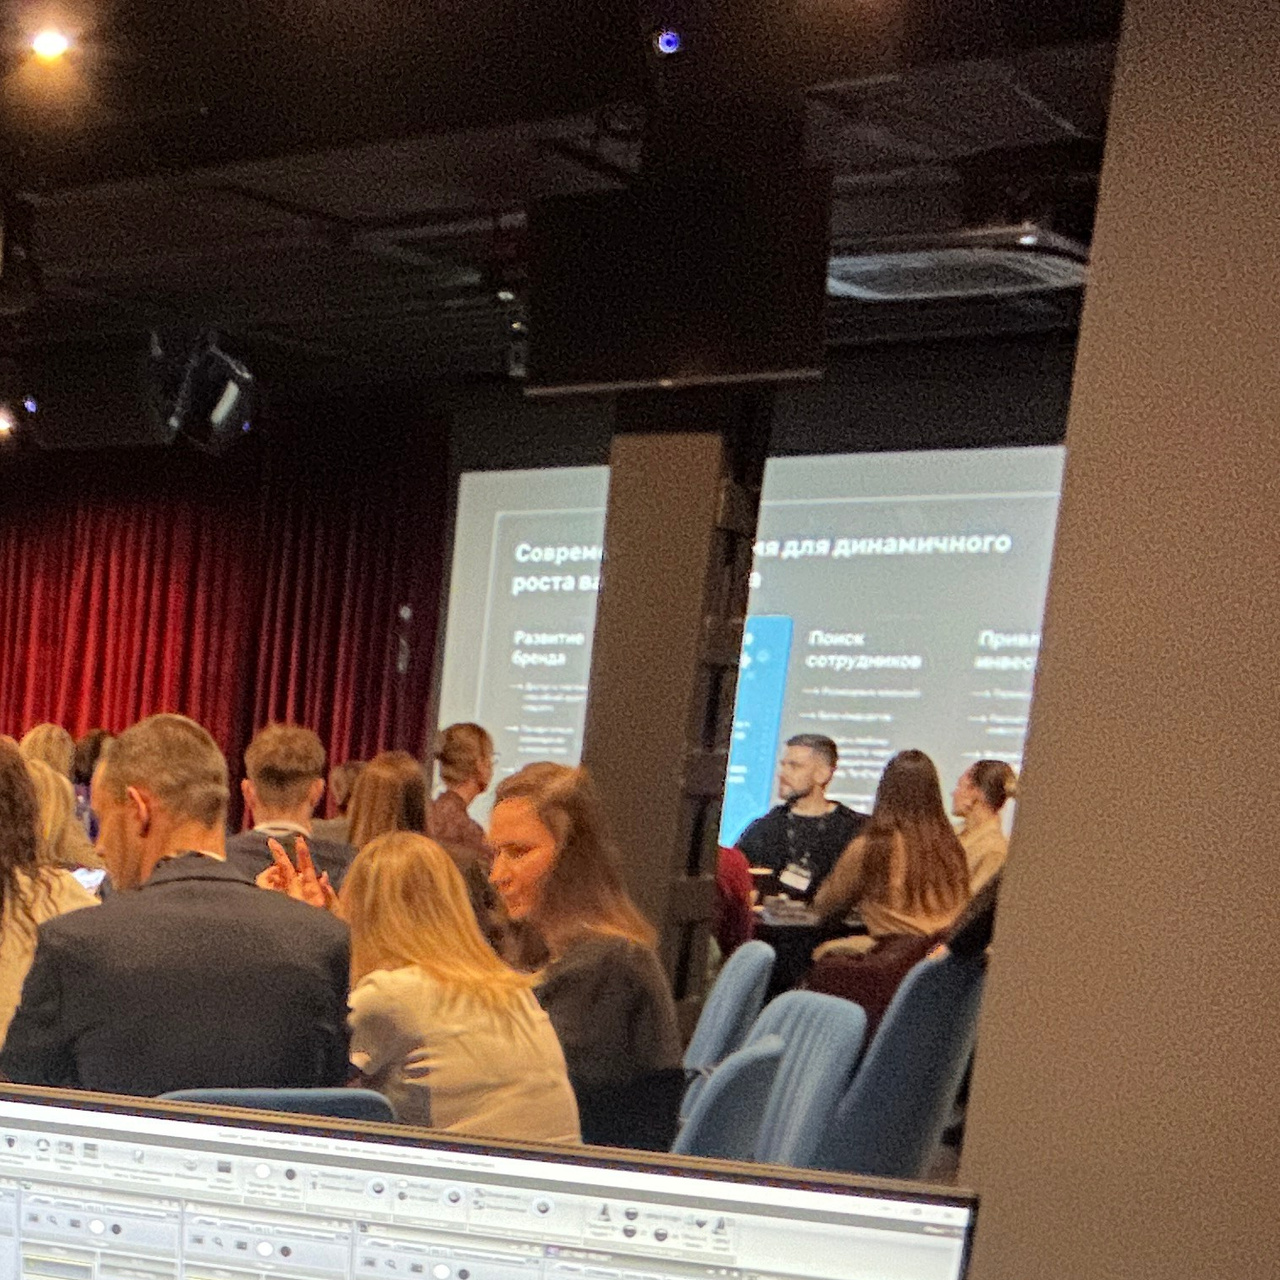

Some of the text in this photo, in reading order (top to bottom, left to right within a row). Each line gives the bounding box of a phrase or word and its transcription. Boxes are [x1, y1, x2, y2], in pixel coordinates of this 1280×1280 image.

[781, 538, 831, 559] для
[832, 534, 1013, 559] динамичного
[512, 575, 575, 597] роста
[808, 630, 866, 647] Поиск
[804, 654, 923, 672] сотрудников
